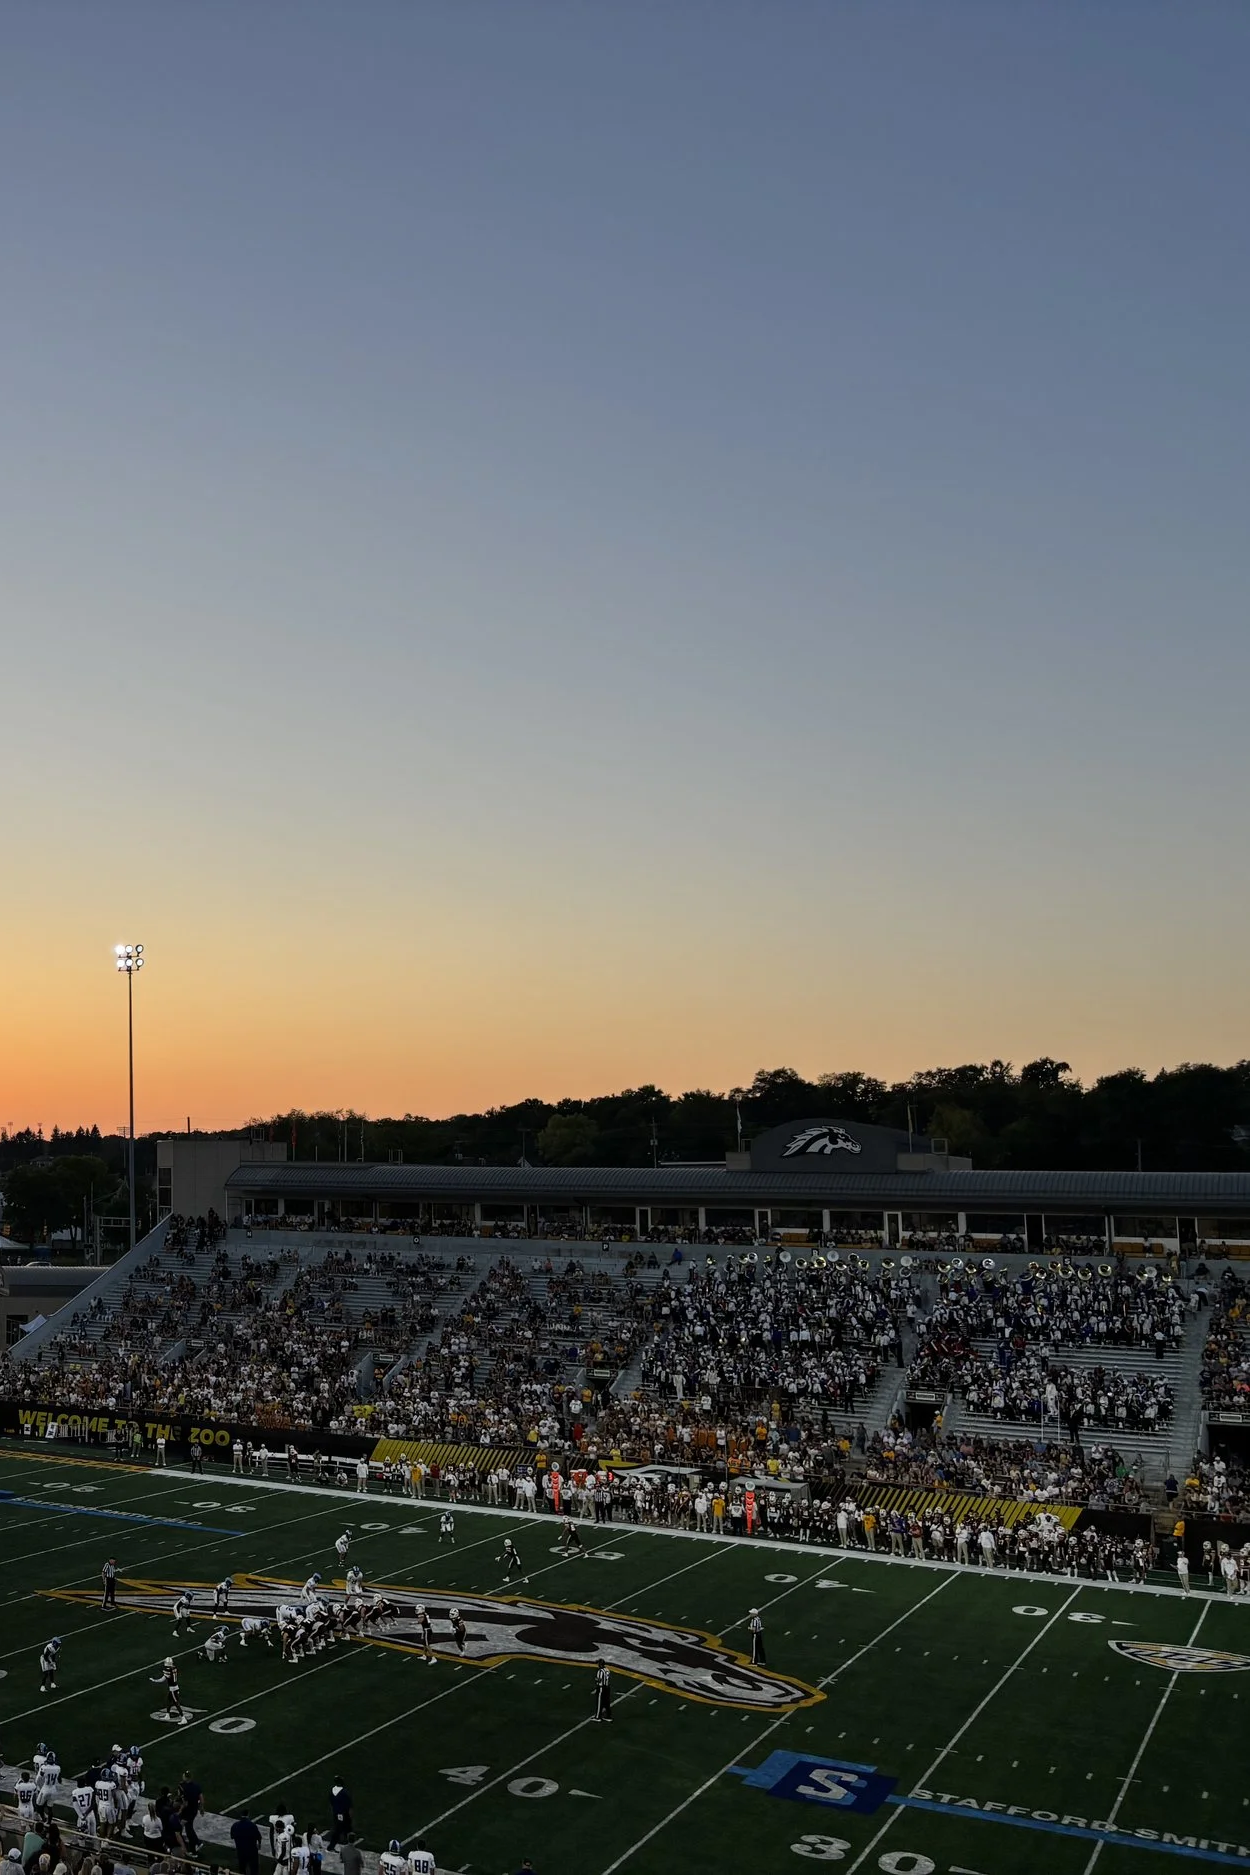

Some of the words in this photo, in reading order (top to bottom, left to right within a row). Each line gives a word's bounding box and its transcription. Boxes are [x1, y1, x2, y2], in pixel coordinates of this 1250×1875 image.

[188, 1427, 232, 1447] ZOO
[438, 1764, 562, 1799] 40
[796, 1767, 861, 1801] S
[78, 1793, 91, 1808] 27
[414, 1859, 429, 1874] 88
[789, 1833, 937, 1875] 30
